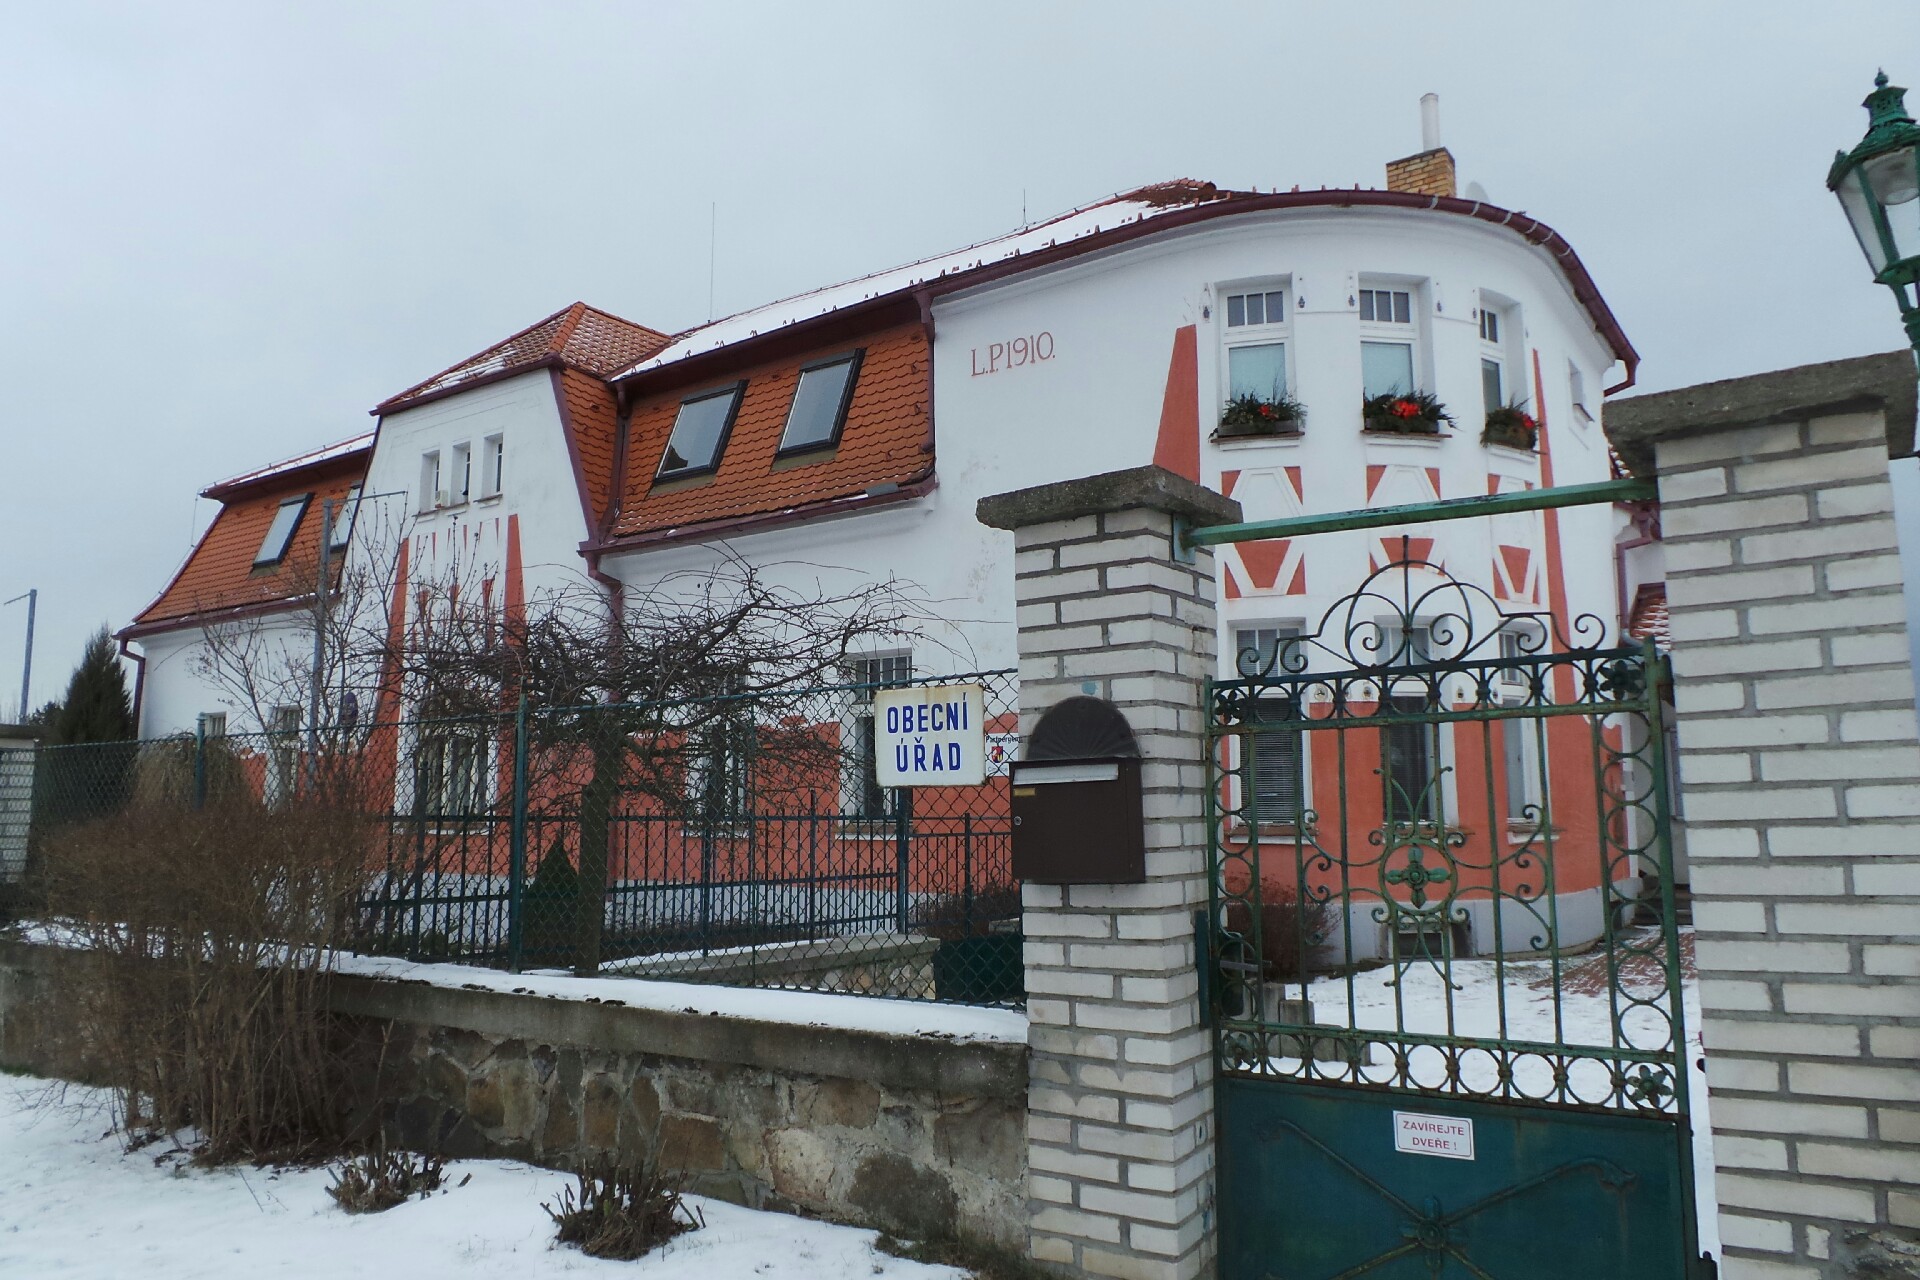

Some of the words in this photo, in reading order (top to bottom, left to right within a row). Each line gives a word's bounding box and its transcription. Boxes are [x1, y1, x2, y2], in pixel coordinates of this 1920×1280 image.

[887, 692, 969, 734] OBECNÍ
[896, 736, 961, 772] ÚŘAD
[1403, 1120, 1464, 1136] ZAVÍREJTE
